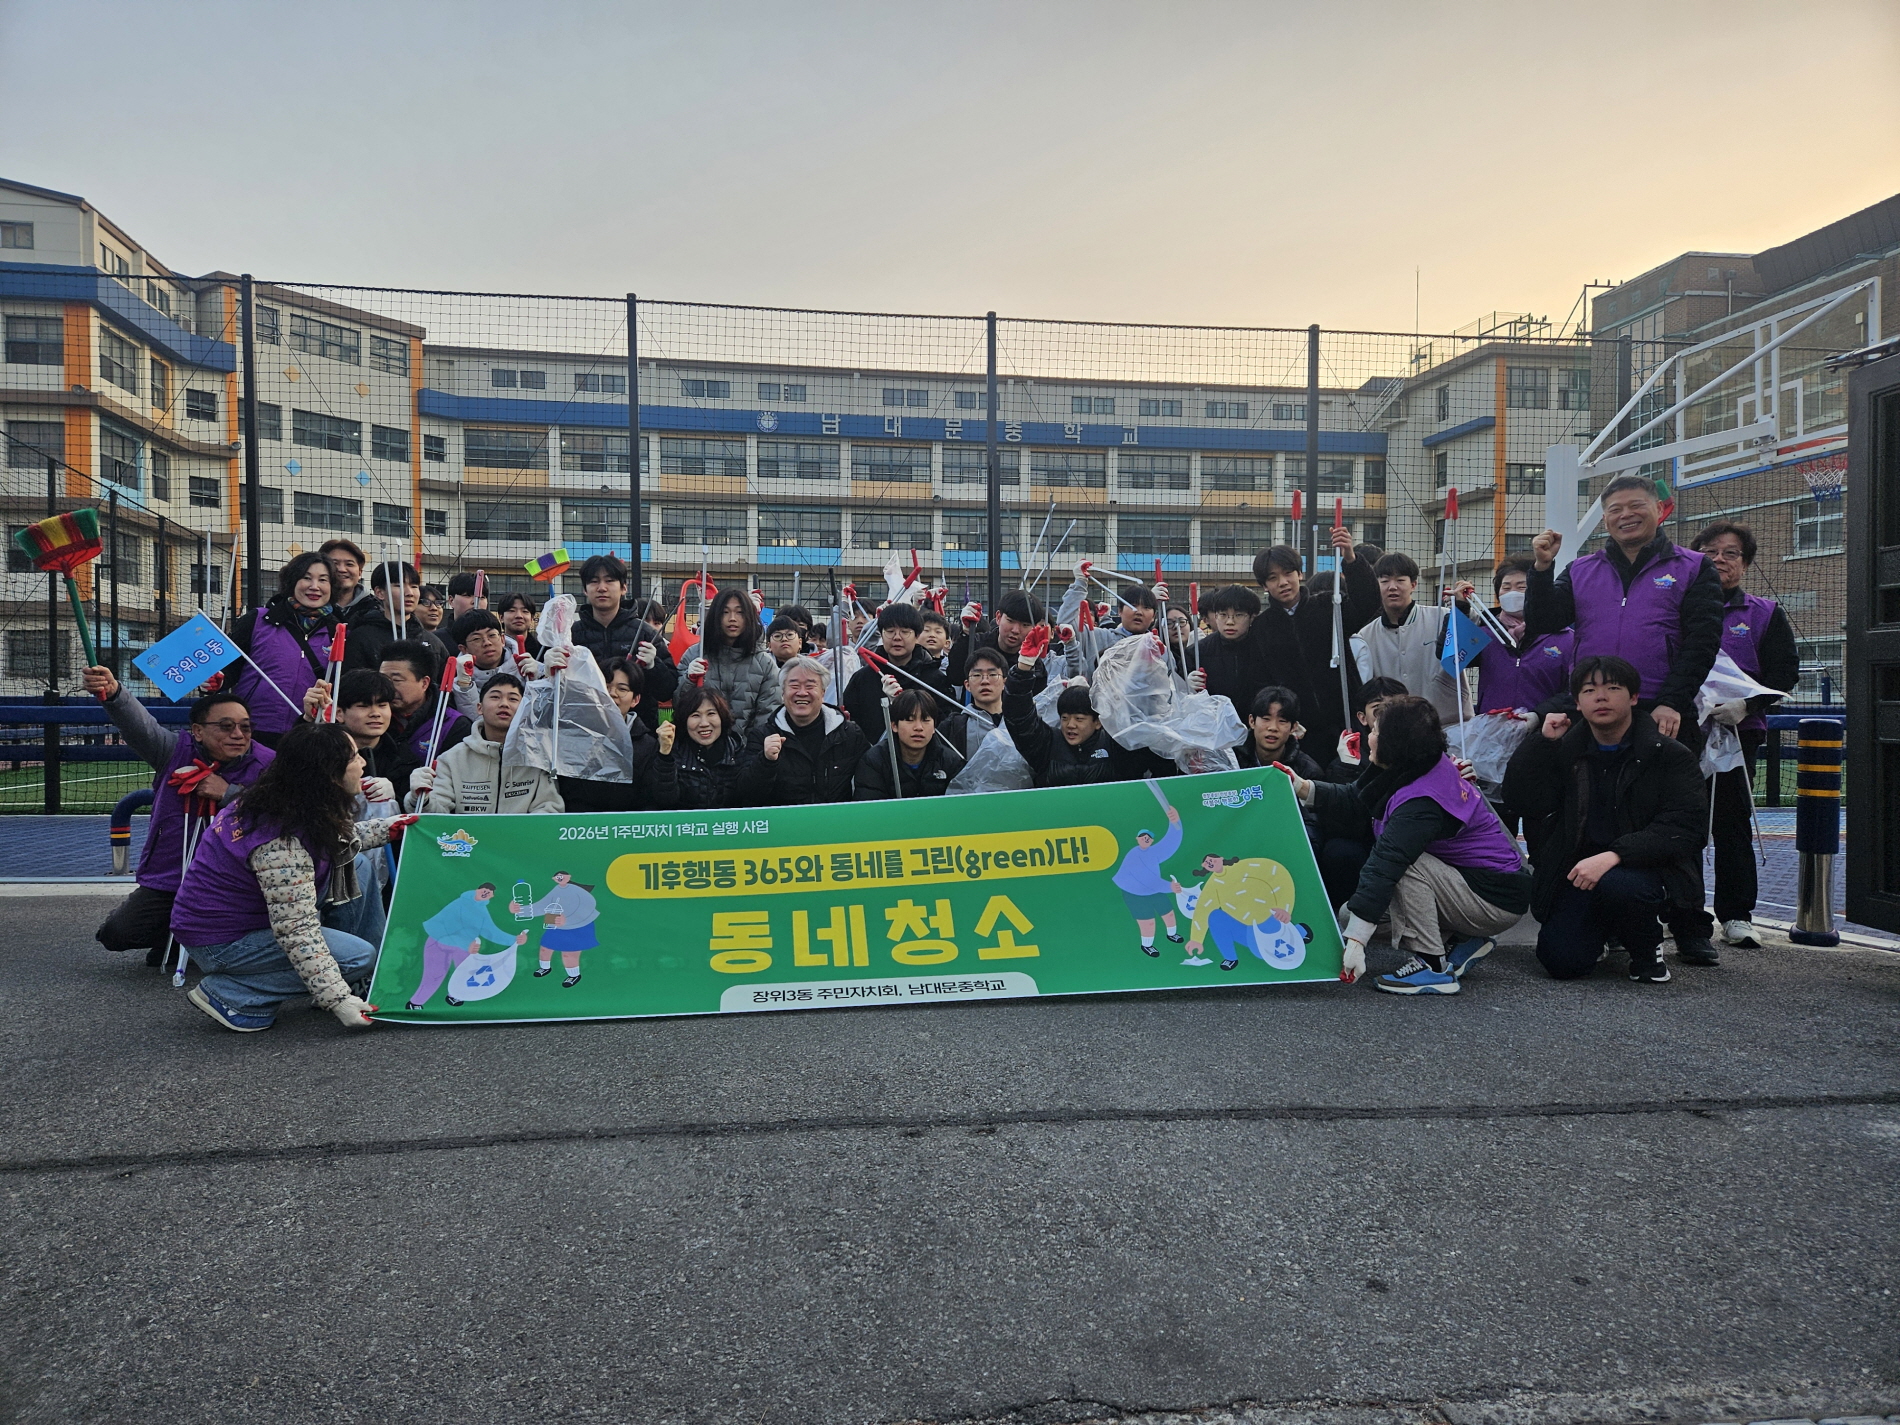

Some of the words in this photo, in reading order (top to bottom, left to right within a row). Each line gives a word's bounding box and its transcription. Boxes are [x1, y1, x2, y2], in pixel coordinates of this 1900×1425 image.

[821, 413, 1139, 445] 남대문중학교
[164, 639, 224, 683] 장위3동
[1240, 785, 1263, 801] 성북
[558, 825, 609, 840] 2026년
[611, 823, 673, 839] 1주민자치
[675, 822, 709, 837] 1학교
[711, 821, 739, 835] 실행
[742, 820, 769, 834] 사업
[638, 859, 737, 890] 기후행동
[743, 854, 824, 886] 365와
[830, 850, 904, 881] 동네를
[909, 836, 1090, 879] 그린(green)다!
[752, 989, 813, 1003] 장위3동
[907, 979, 1007, 996] 남대문중학교
